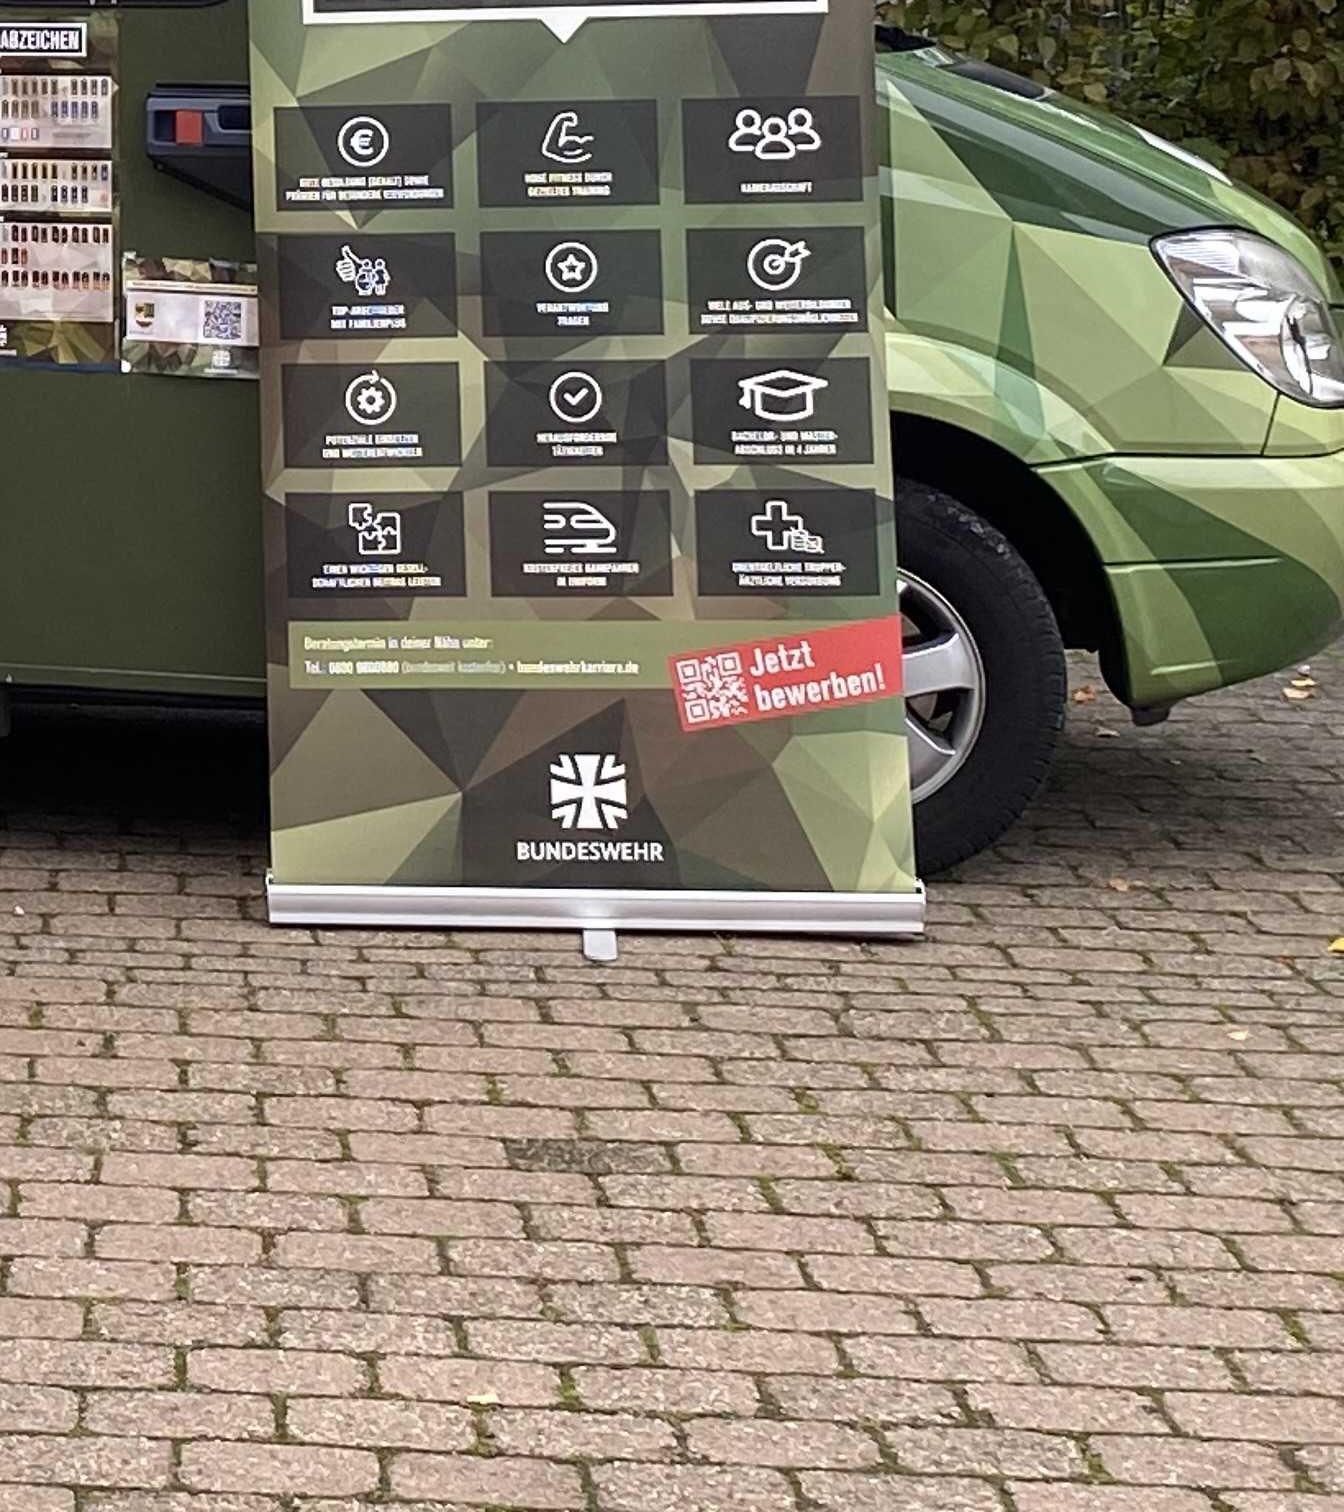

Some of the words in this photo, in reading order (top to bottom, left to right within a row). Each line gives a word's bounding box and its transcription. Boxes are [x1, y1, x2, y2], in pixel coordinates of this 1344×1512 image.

[750, 640, 816, 677] Jetzt
[753, 662, 886, 711] bewerben!
[515, 840, 665, 862] BUNDESWEHR
